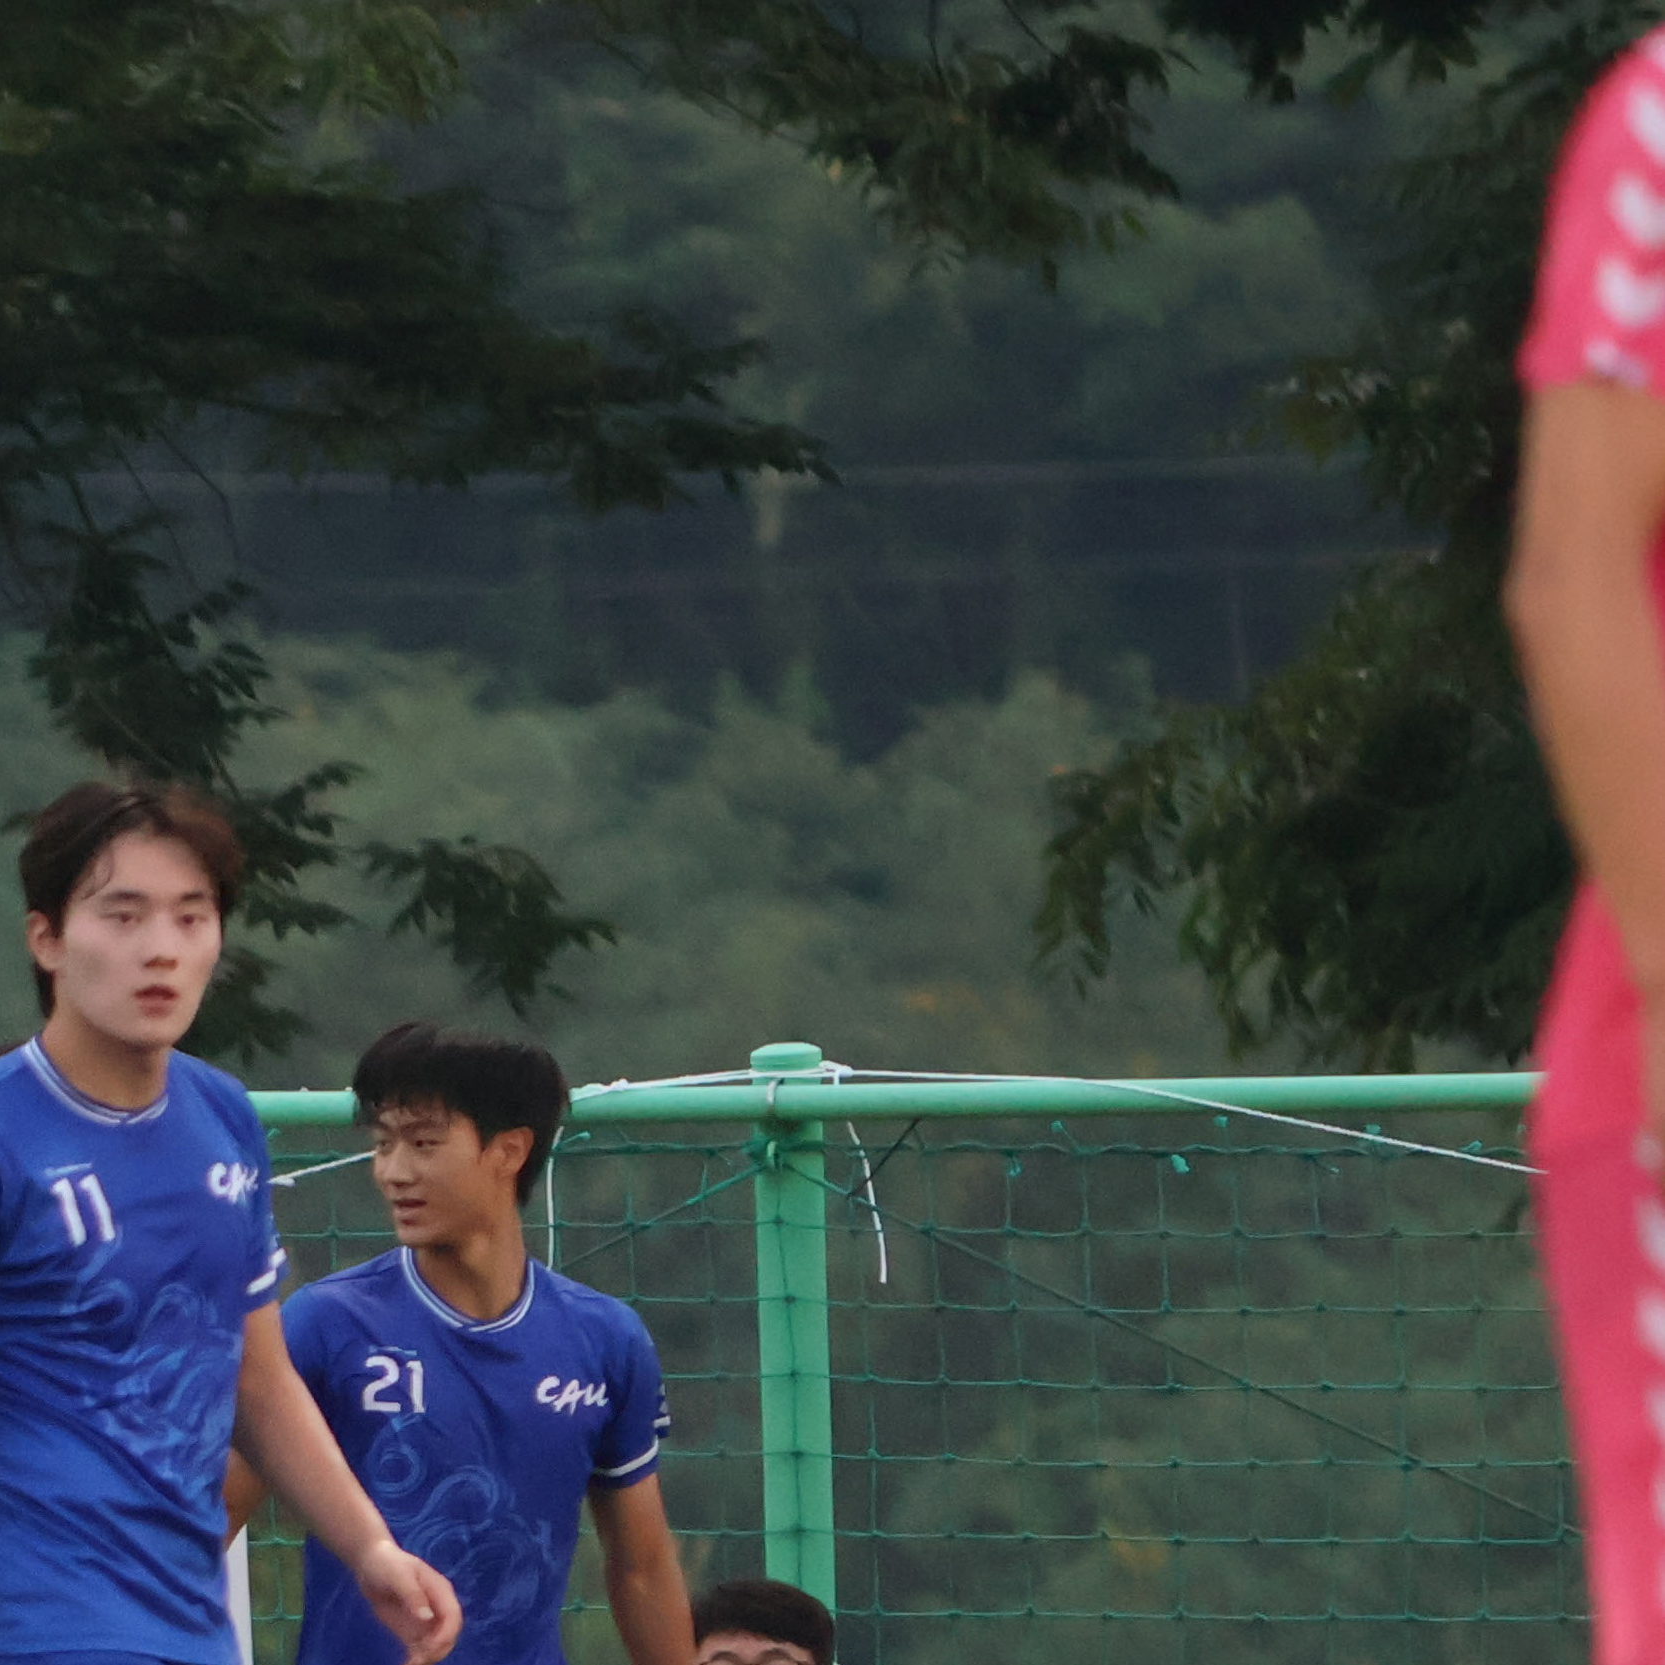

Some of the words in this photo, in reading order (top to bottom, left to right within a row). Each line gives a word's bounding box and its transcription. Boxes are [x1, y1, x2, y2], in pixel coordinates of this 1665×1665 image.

[50, 1173, 117, 1248] 11
[362, 1354, 427, 1414] 21
[536, 1375, 610, 1416] CAU
